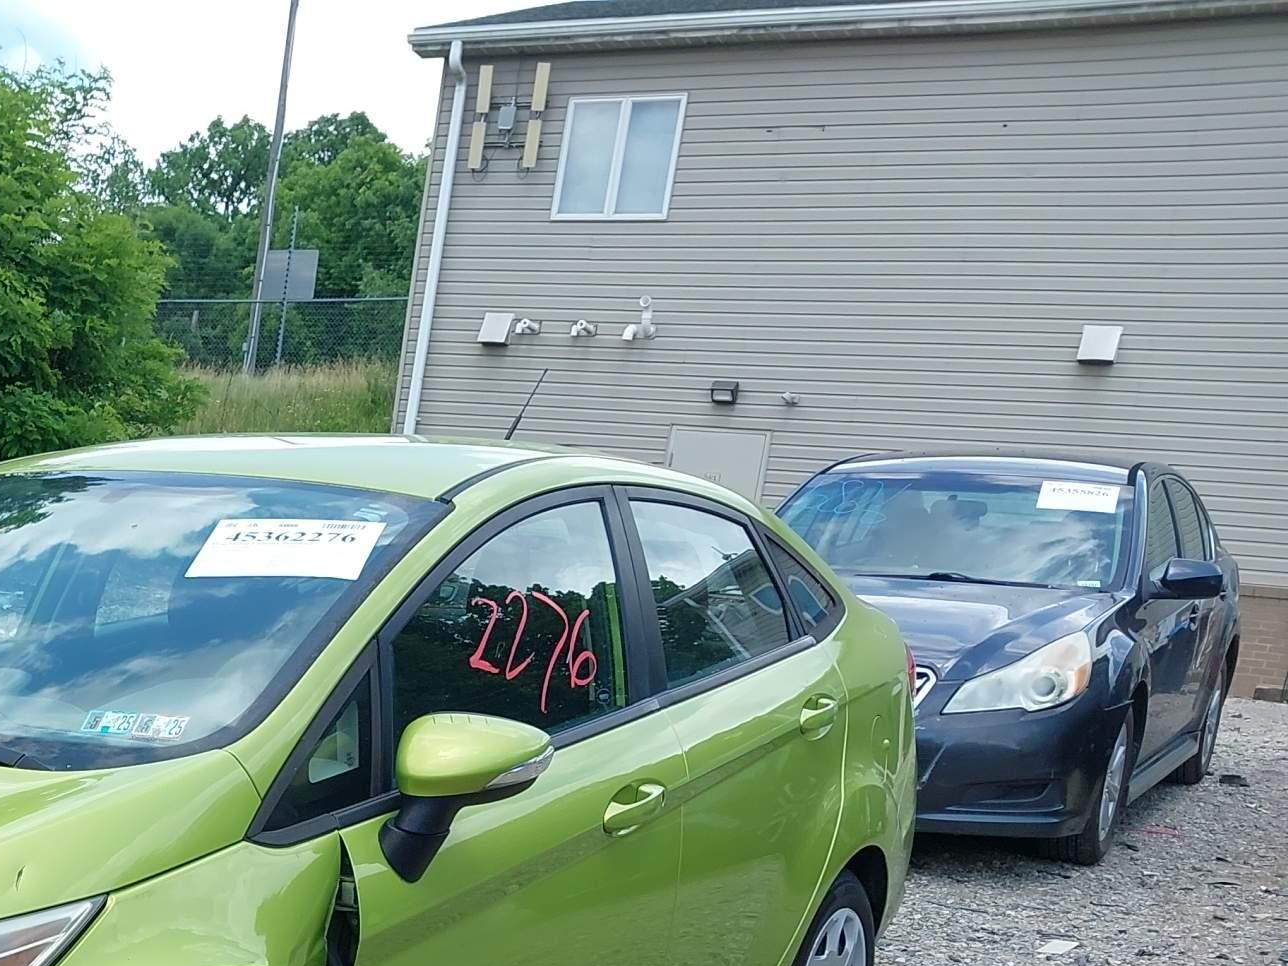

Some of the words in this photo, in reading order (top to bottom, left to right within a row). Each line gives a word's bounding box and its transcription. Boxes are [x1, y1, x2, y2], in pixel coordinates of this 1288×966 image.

[224, 531, 358, 544] 45362276
[469, 590, 598, 714] 2276
[116, 714, 135, 731] 25
[168, 718, 186, 736] 25
